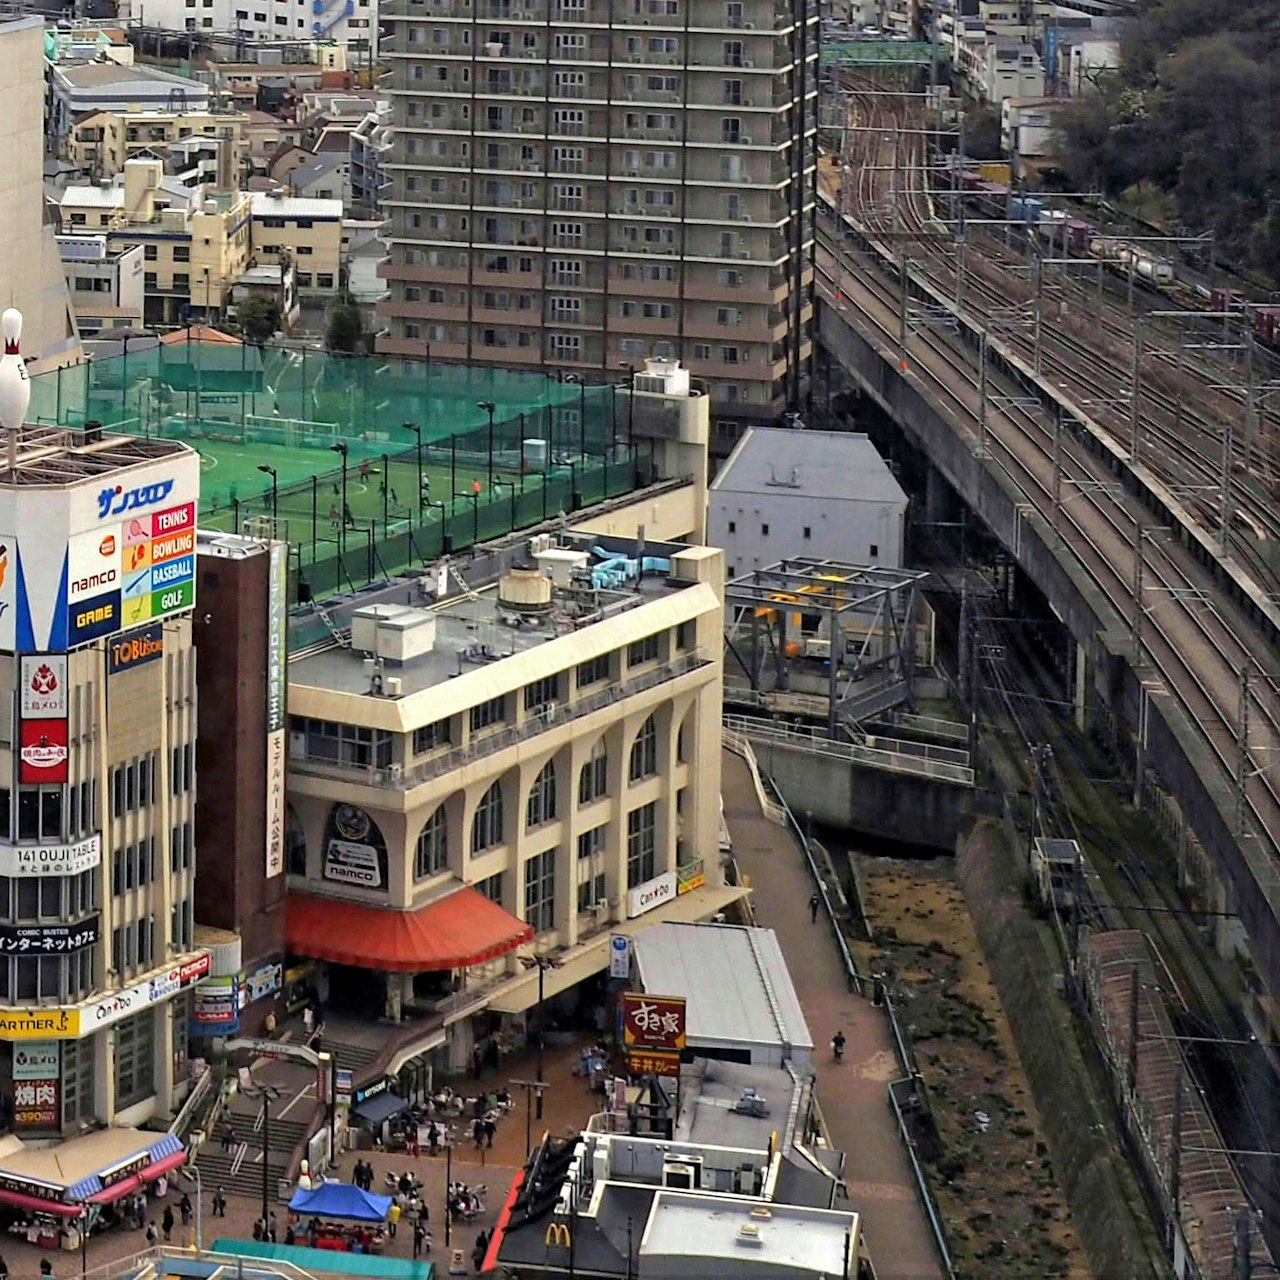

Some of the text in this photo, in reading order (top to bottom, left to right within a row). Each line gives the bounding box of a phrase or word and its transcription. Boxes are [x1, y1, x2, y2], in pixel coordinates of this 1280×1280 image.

[98, 479, 174, 519] サンスクエア
[158, 508, 188, 530] TENNIS
[153, 535, 192, 559] BOWLING
[72, 569, 116, 594] namco
[153, 561, 191, 585] BASEBALL
[161, 590, 183, 609] GOLF
[77, 605, 113, 628] GAME
[113, 638, 147, 667] TOBU
[271, 737, 281, 869] モデルルーム公開中
[18, 841, 96, 861] 141 OUJI TABLE
[330, 867, 373, 880] namco
[631, 1001, 680, 1035] すき家
[15, 1084, 56, 1106] 焼肉
